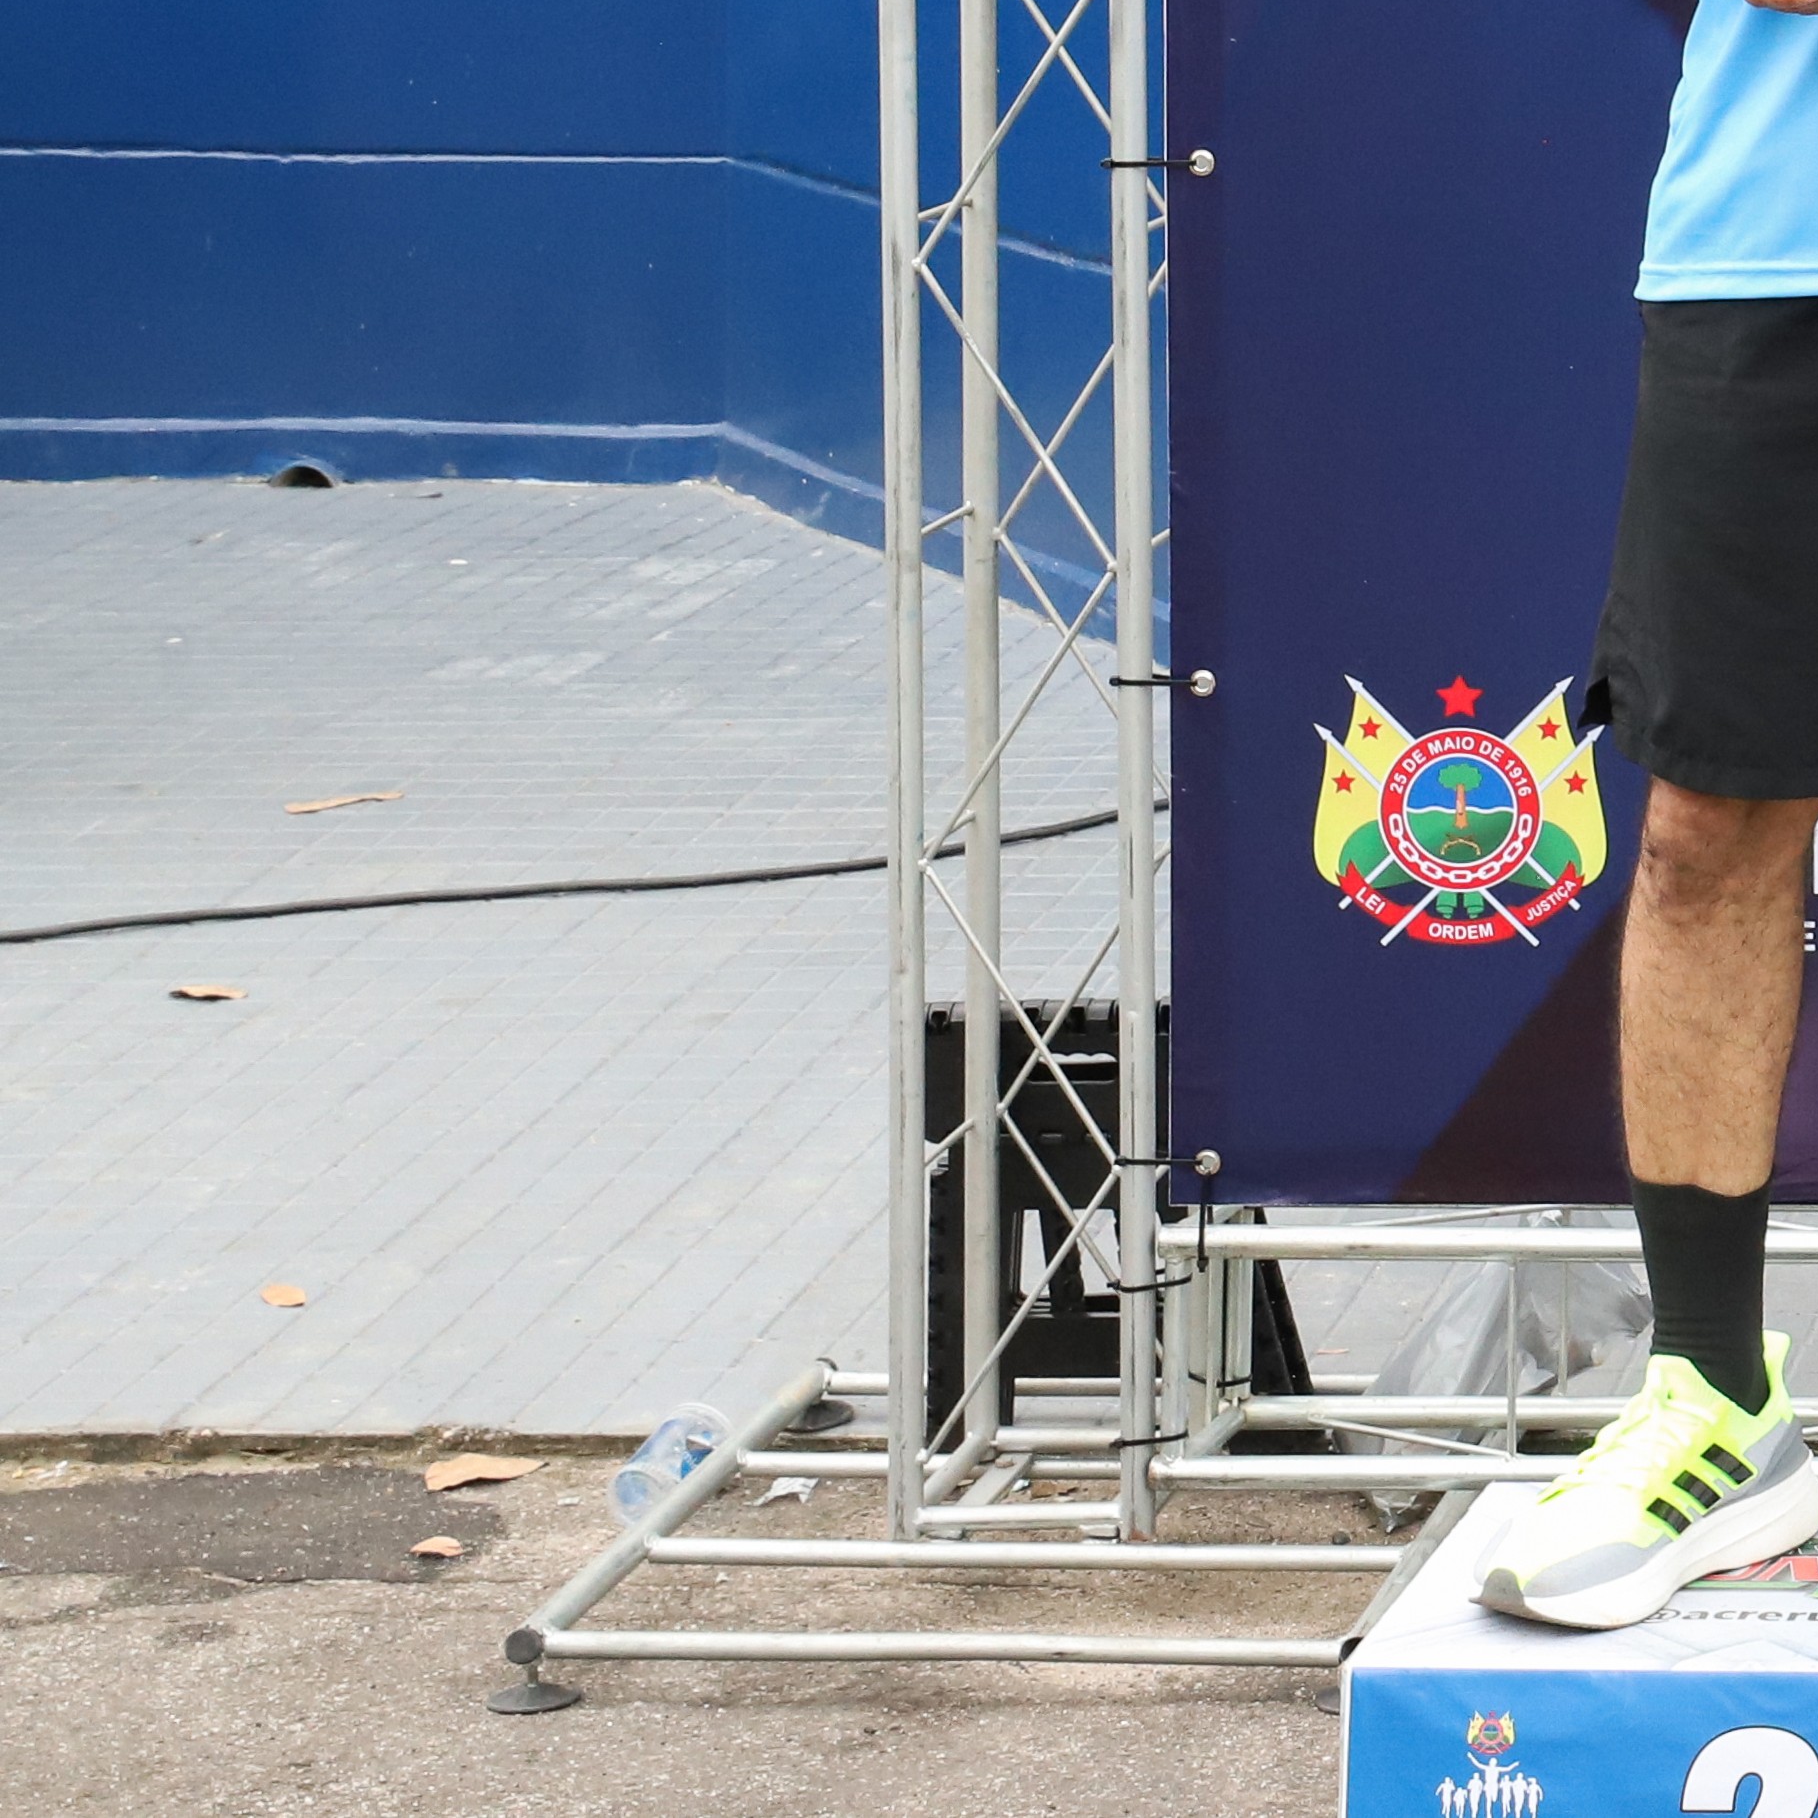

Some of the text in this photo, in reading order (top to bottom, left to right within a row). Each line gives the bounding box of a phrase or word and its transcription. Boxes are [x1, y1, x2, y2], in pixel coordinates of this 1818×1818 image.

[1388, 735, 1533, 798] 25 DE MAIO DE 1916
[1354, 886, 1387, 915] LEI
[1525, 879, 1577, 922] JUSTIÇA
[1427, 922, 1494, 940] ORDEM
